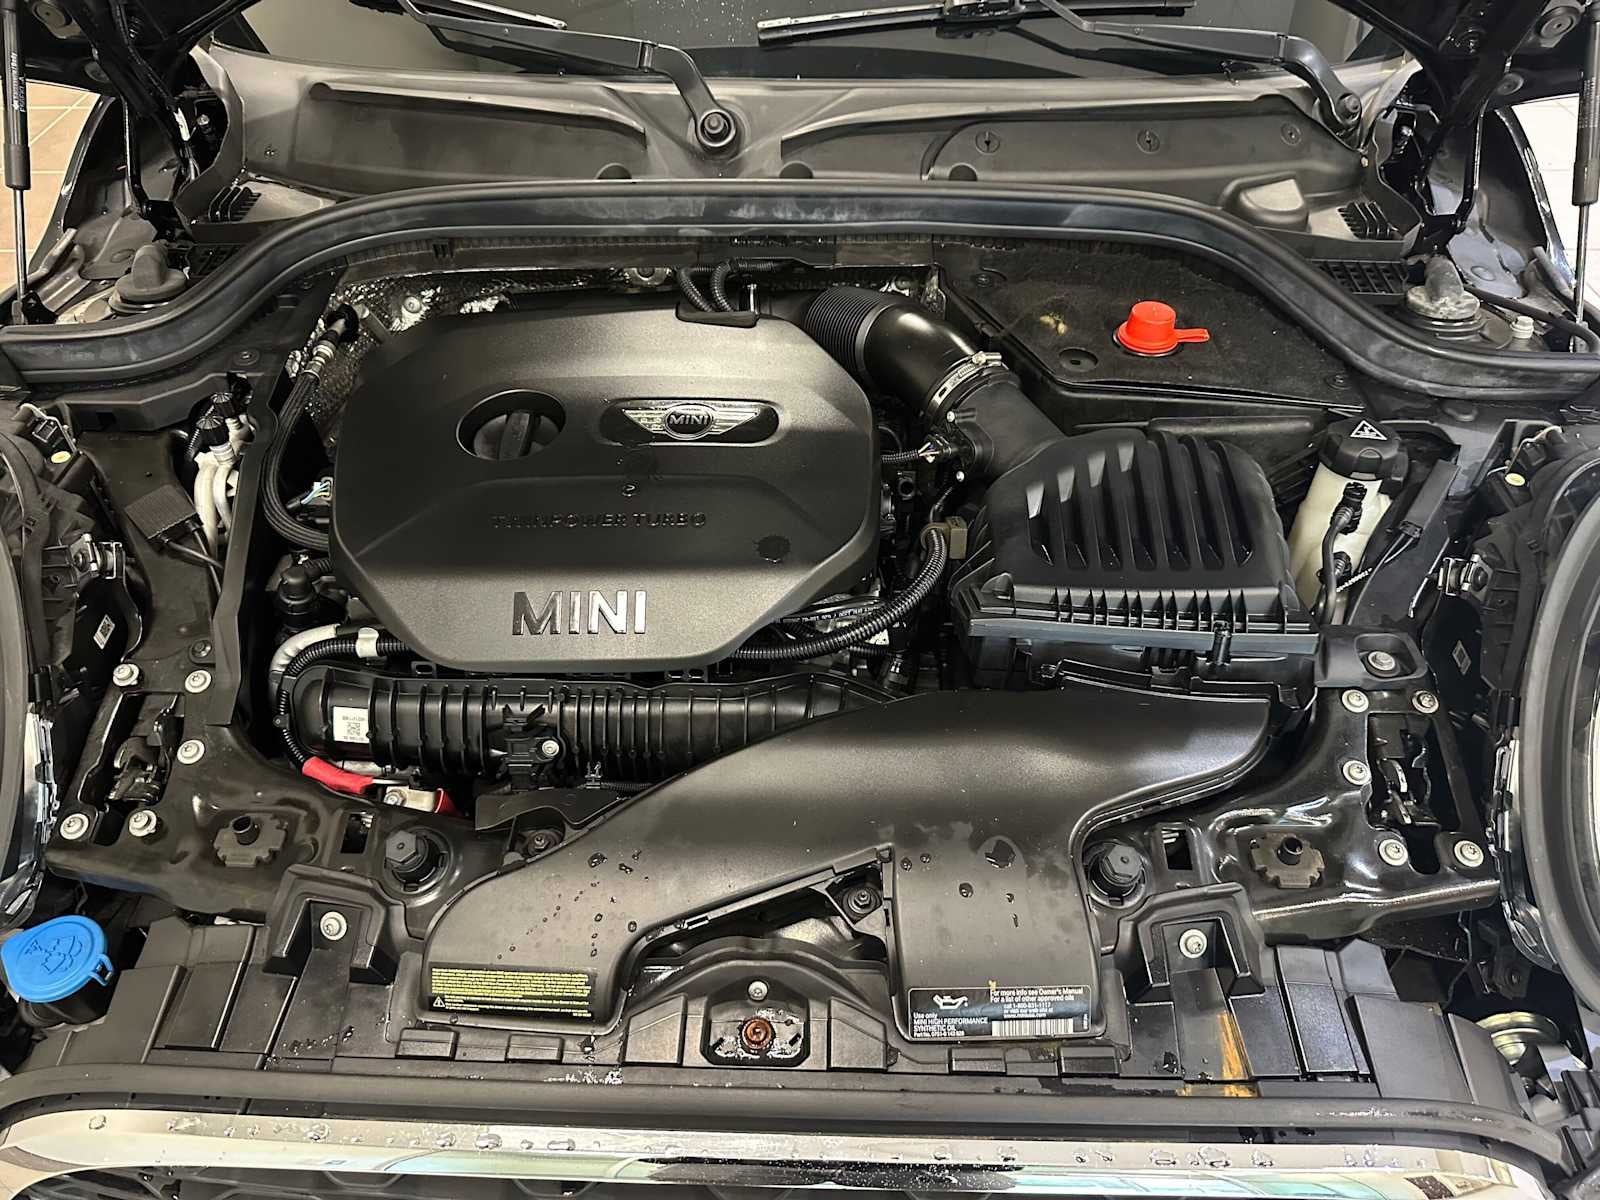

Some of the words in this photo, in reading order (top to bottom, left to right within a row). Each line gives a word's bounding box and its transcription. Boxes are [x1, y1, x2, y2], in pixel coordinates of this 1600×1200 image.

[669, 414, 709, 425] MINI
[633, 512, 706, 528] TURBO
[512, 590, 646, 635] MINI
[1039, 988, 1062, 996] Owner's
[1062, 987, 1083, 995] Manual
[991, 996, 1000, 1004] For
[1014, 995, 1021, 1003] of
[1037, 994, 1064, 1002] approved
[925, 1012, 938, 1020] only
[943, 1016, 988, 1025] PERFORMANCE
[913, 1024, 947, 1032] SYNTHETIC
